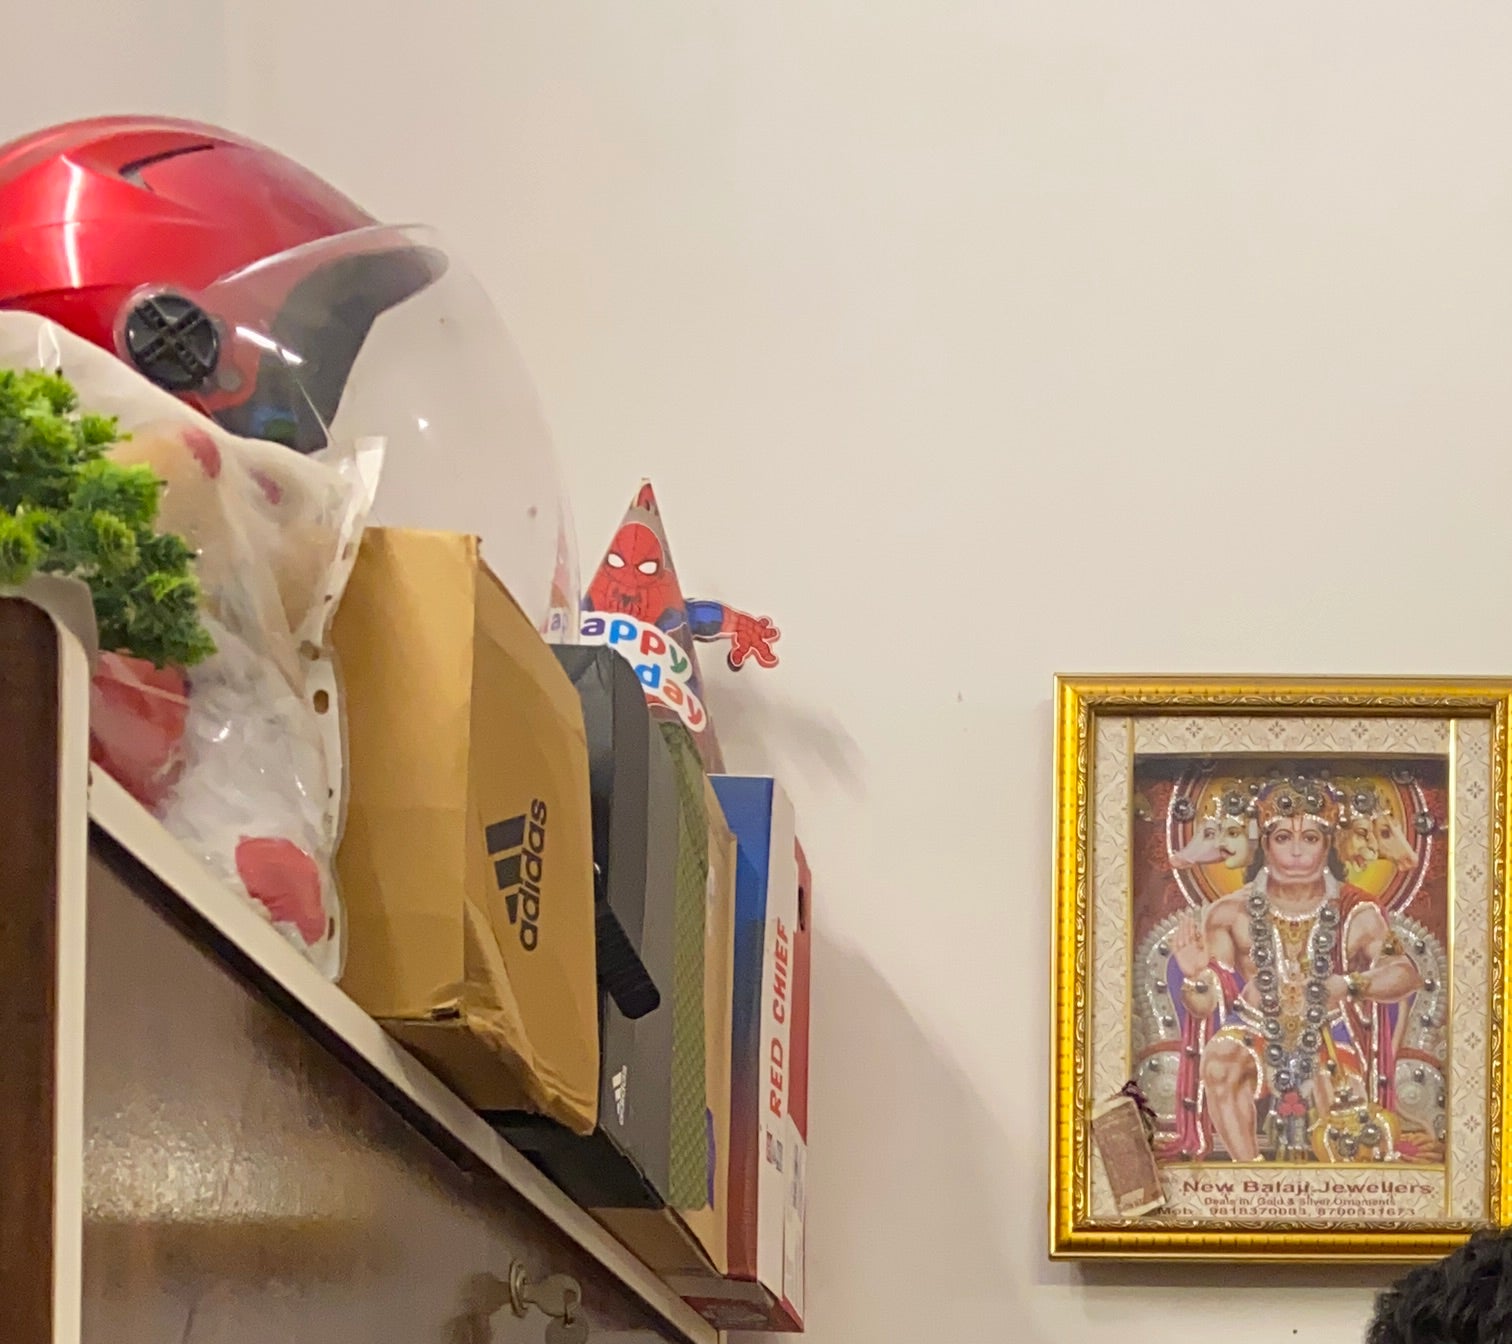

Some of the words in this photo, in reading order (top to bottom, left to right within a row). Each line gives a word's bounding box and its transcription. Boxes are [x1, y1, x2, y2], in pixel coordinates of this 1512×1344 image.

[580, 617, 688, 674] appy
[519, 798, 547, 952] adidas
[773, 918, 789, 1025] CHIEF
[769, 1039, 783, 1118] RED
[1183, 1181, 1234, 1192] New
[1318, 1181, 1432, 1194] Jewellers
